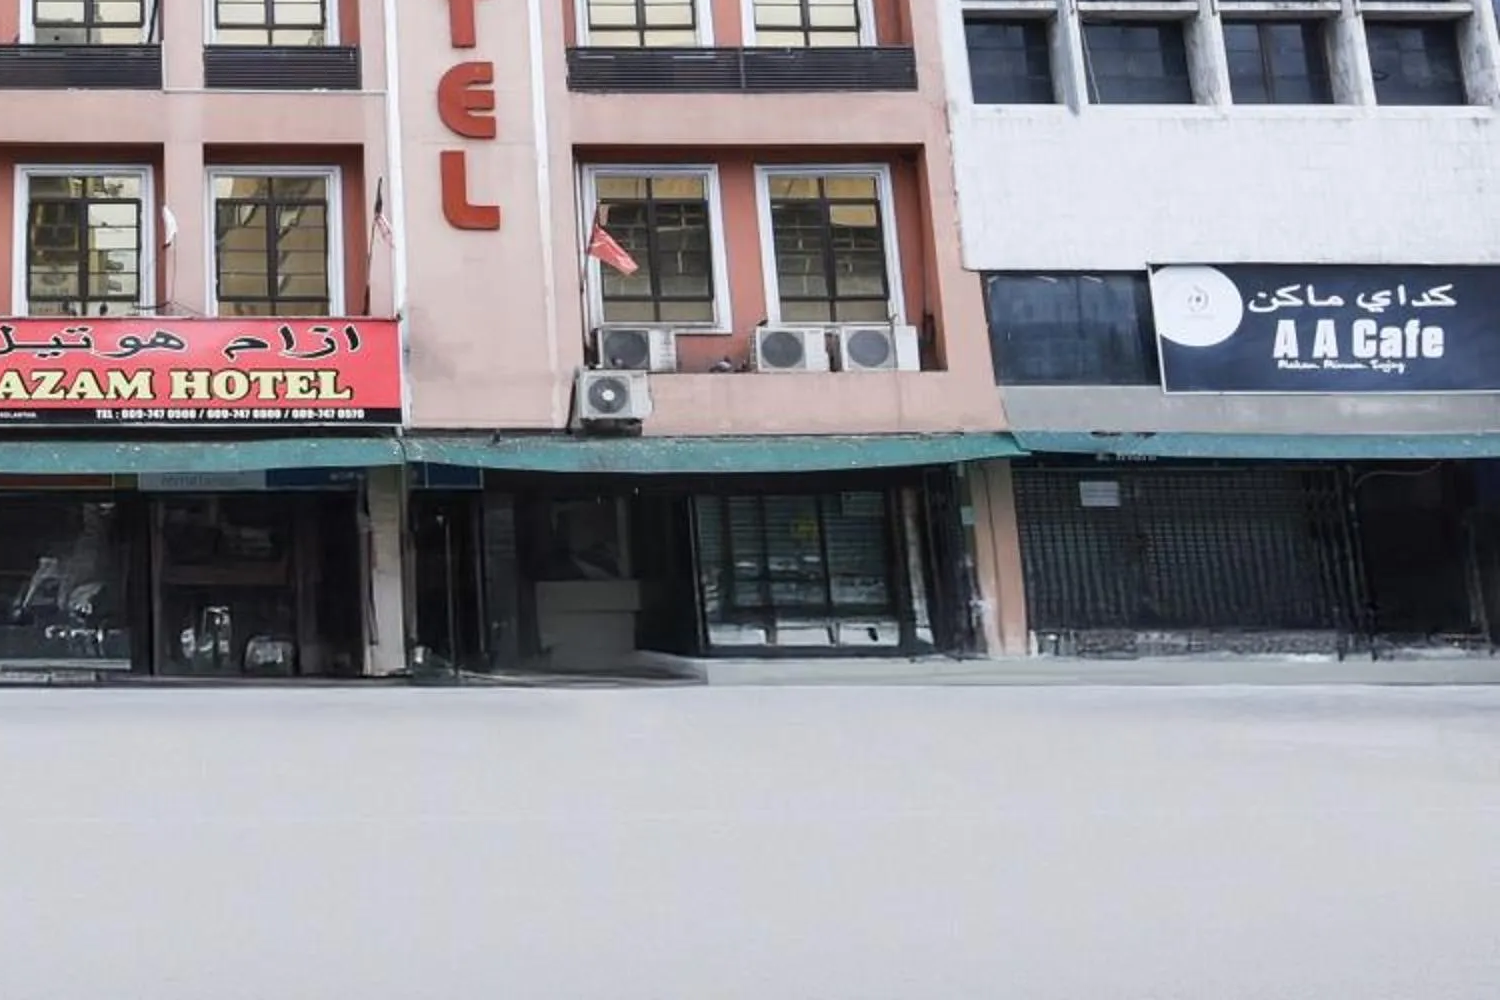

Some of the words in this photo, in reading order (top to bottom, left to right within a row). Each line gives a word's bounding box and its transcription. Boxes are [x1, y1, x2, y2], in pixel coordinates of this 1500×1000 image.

[1272, 318, 1299, 359] A
[1312, 318, 1339, 359] A
[1352, 318, 1445, 359] Cafe
[169, 368, 353, 400] HOTEL
